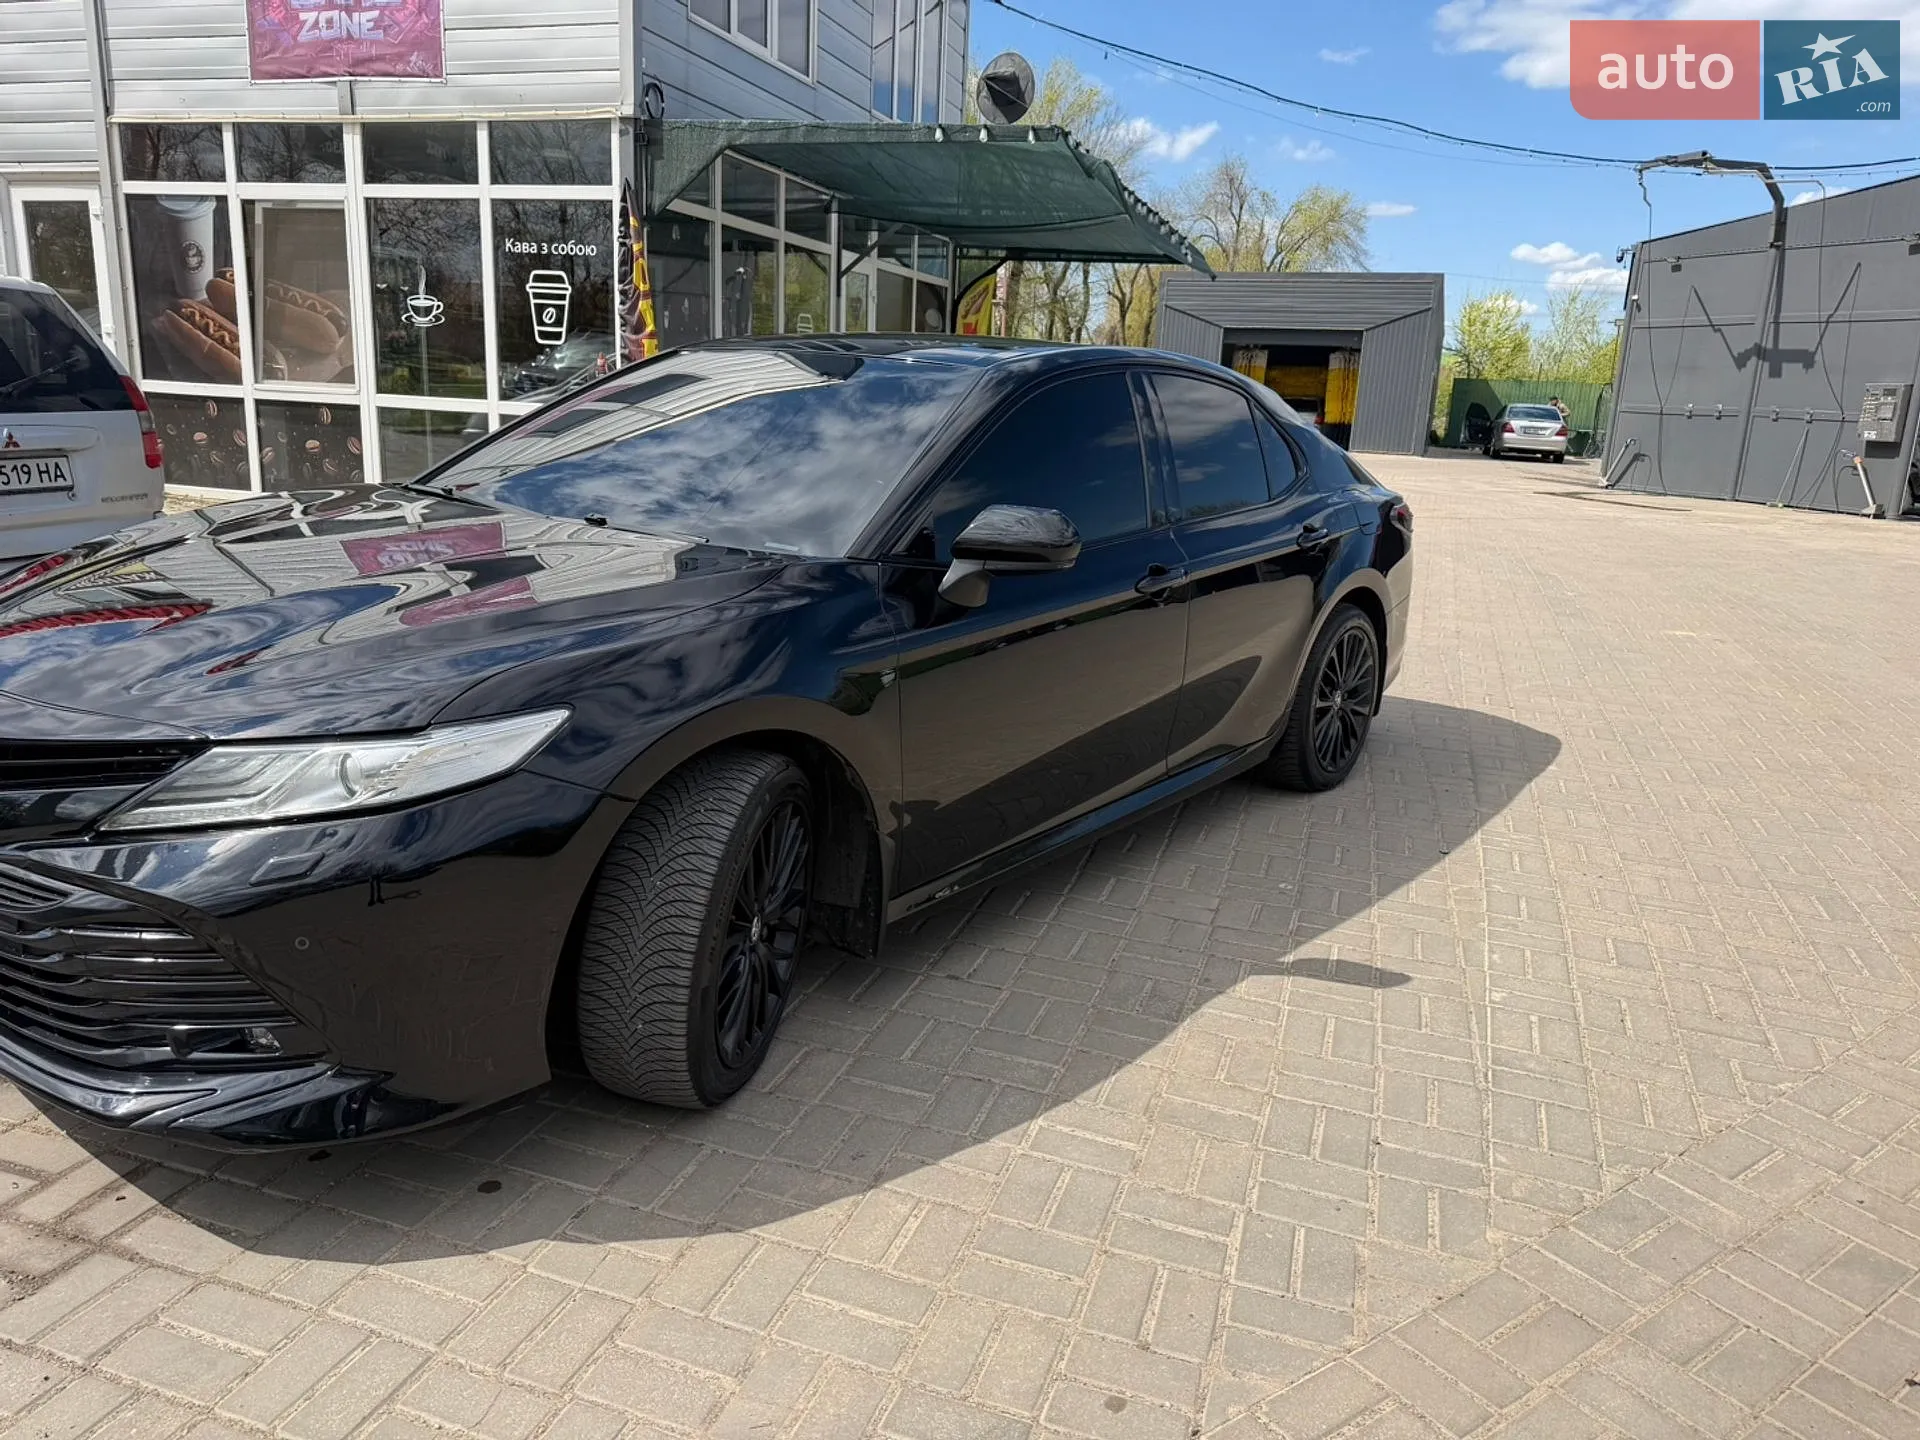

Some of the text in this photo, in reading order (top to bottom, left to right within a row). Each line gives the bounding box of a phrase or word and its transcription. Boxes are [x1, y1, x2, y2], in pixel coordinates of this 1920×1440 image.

[297, 10, 385, 41] ZONE
[504, 238, 597, 256] Кава з собою
[36, 461, 67, 484] HA
